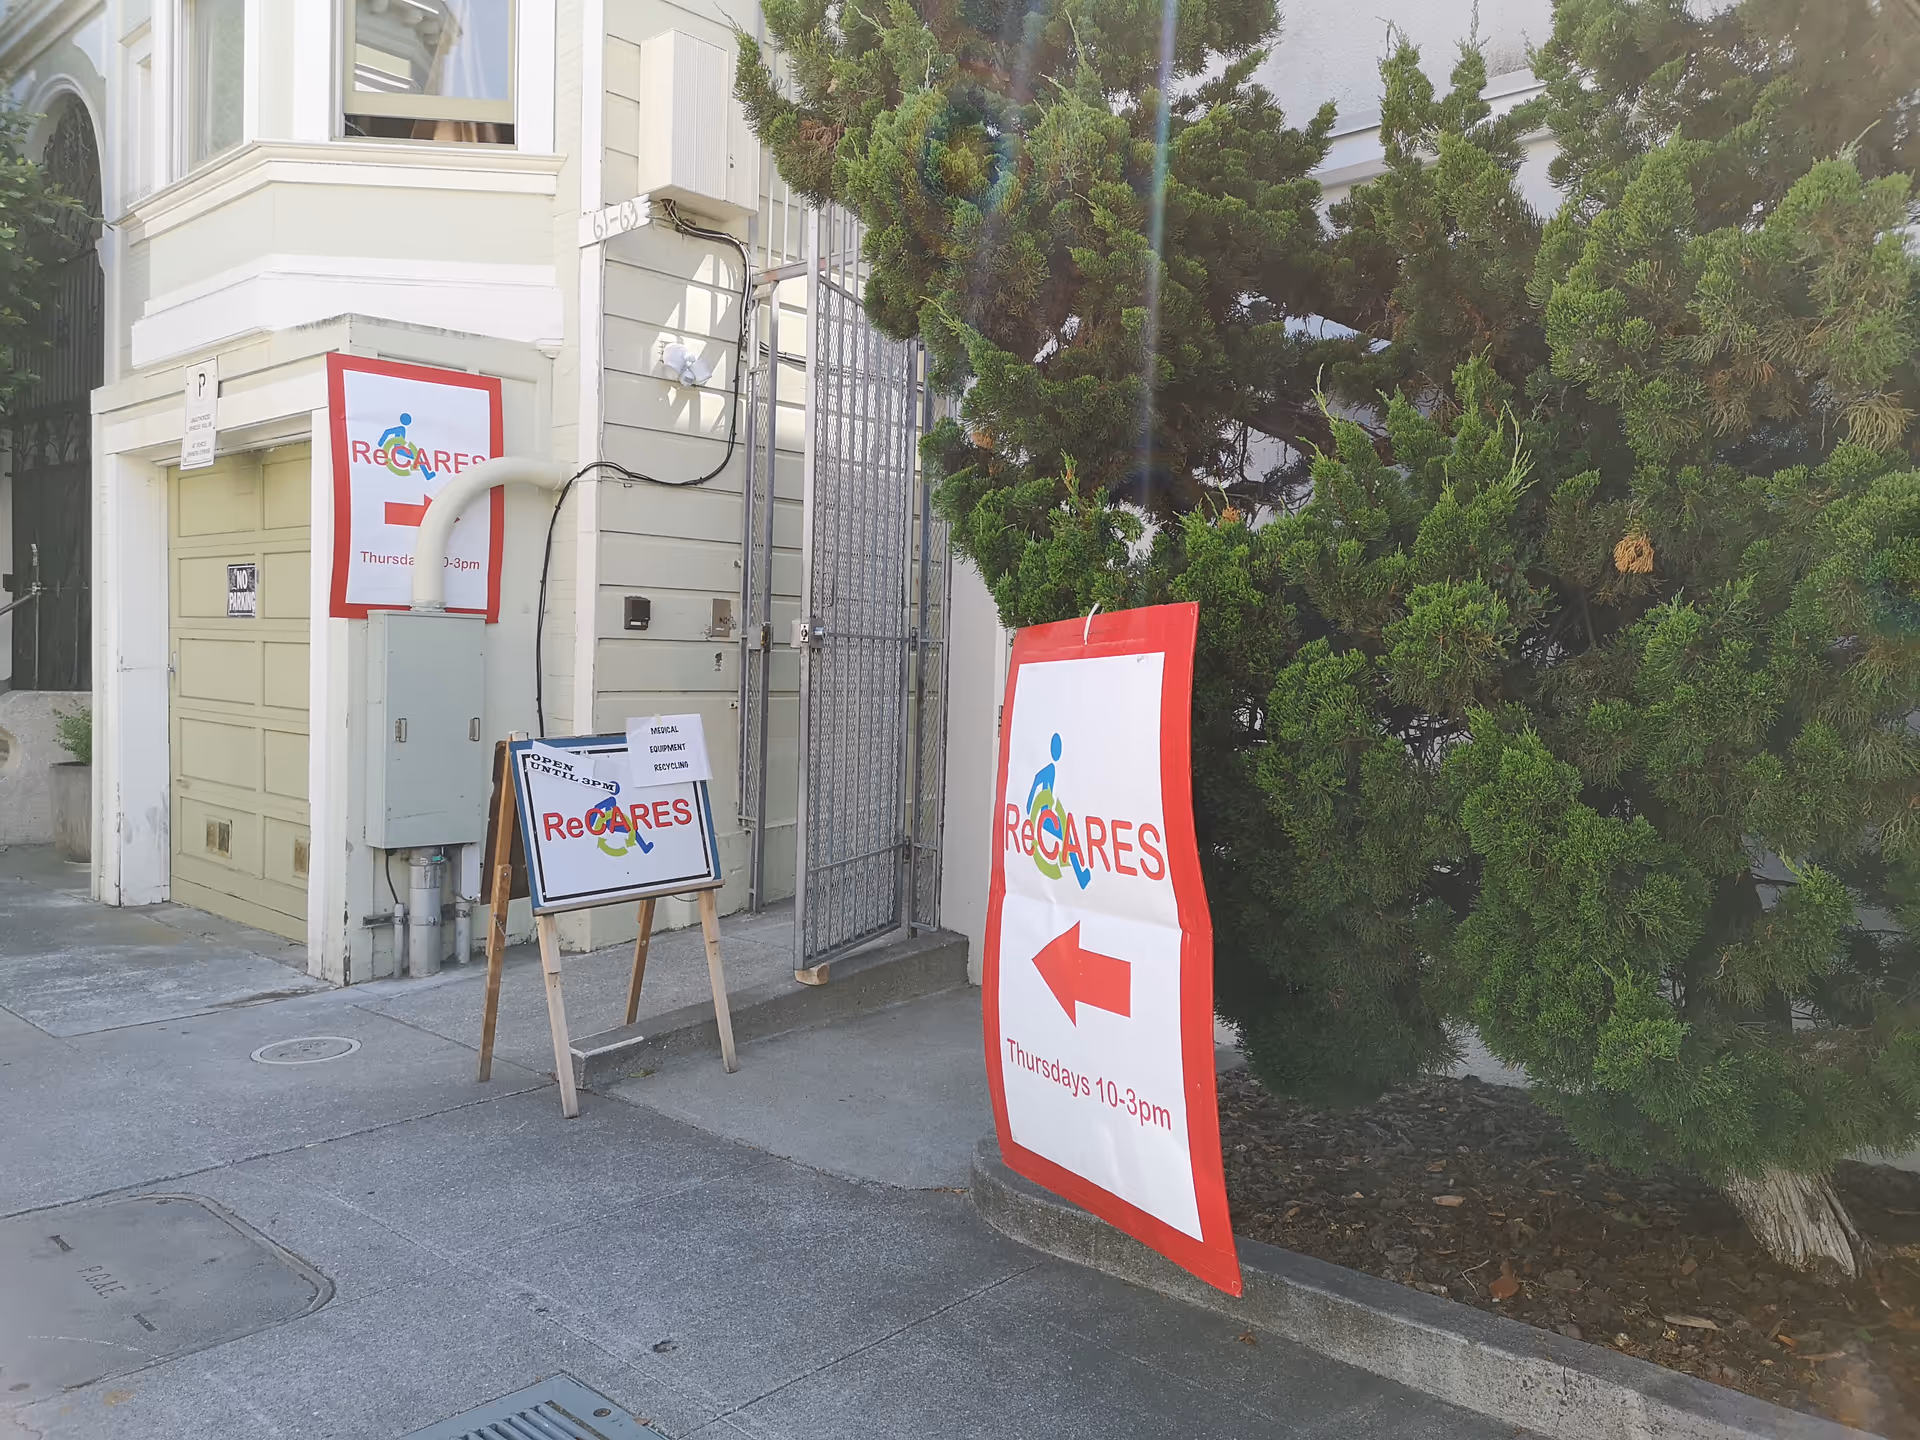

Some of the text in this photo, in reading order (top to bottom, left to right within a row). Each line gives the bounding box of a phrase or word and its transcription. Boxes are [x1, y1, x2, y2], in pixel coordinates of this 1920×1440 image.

[592, 200, 639, 240] 61-63
[360, 551, 414, 567] Thursda
[236, 569, 248, 590] NO
[229, 591, 256, 613] PARKING
[650, 725, 679, 735] MEDICAL
[649, 743, 686, 753] EQUIPMENT
[530, 753, 574, 772] OPEN
[653, 760, 689, 772] RECYCLING
[530, 761, 615, 792] UNTIL 3PM
[542, 798, 693, 842] ReCARES
[1005, 803, 1166, 881] ReCARES
[1006, 1037, 1172, 1131] Thursdays 10-3pm
